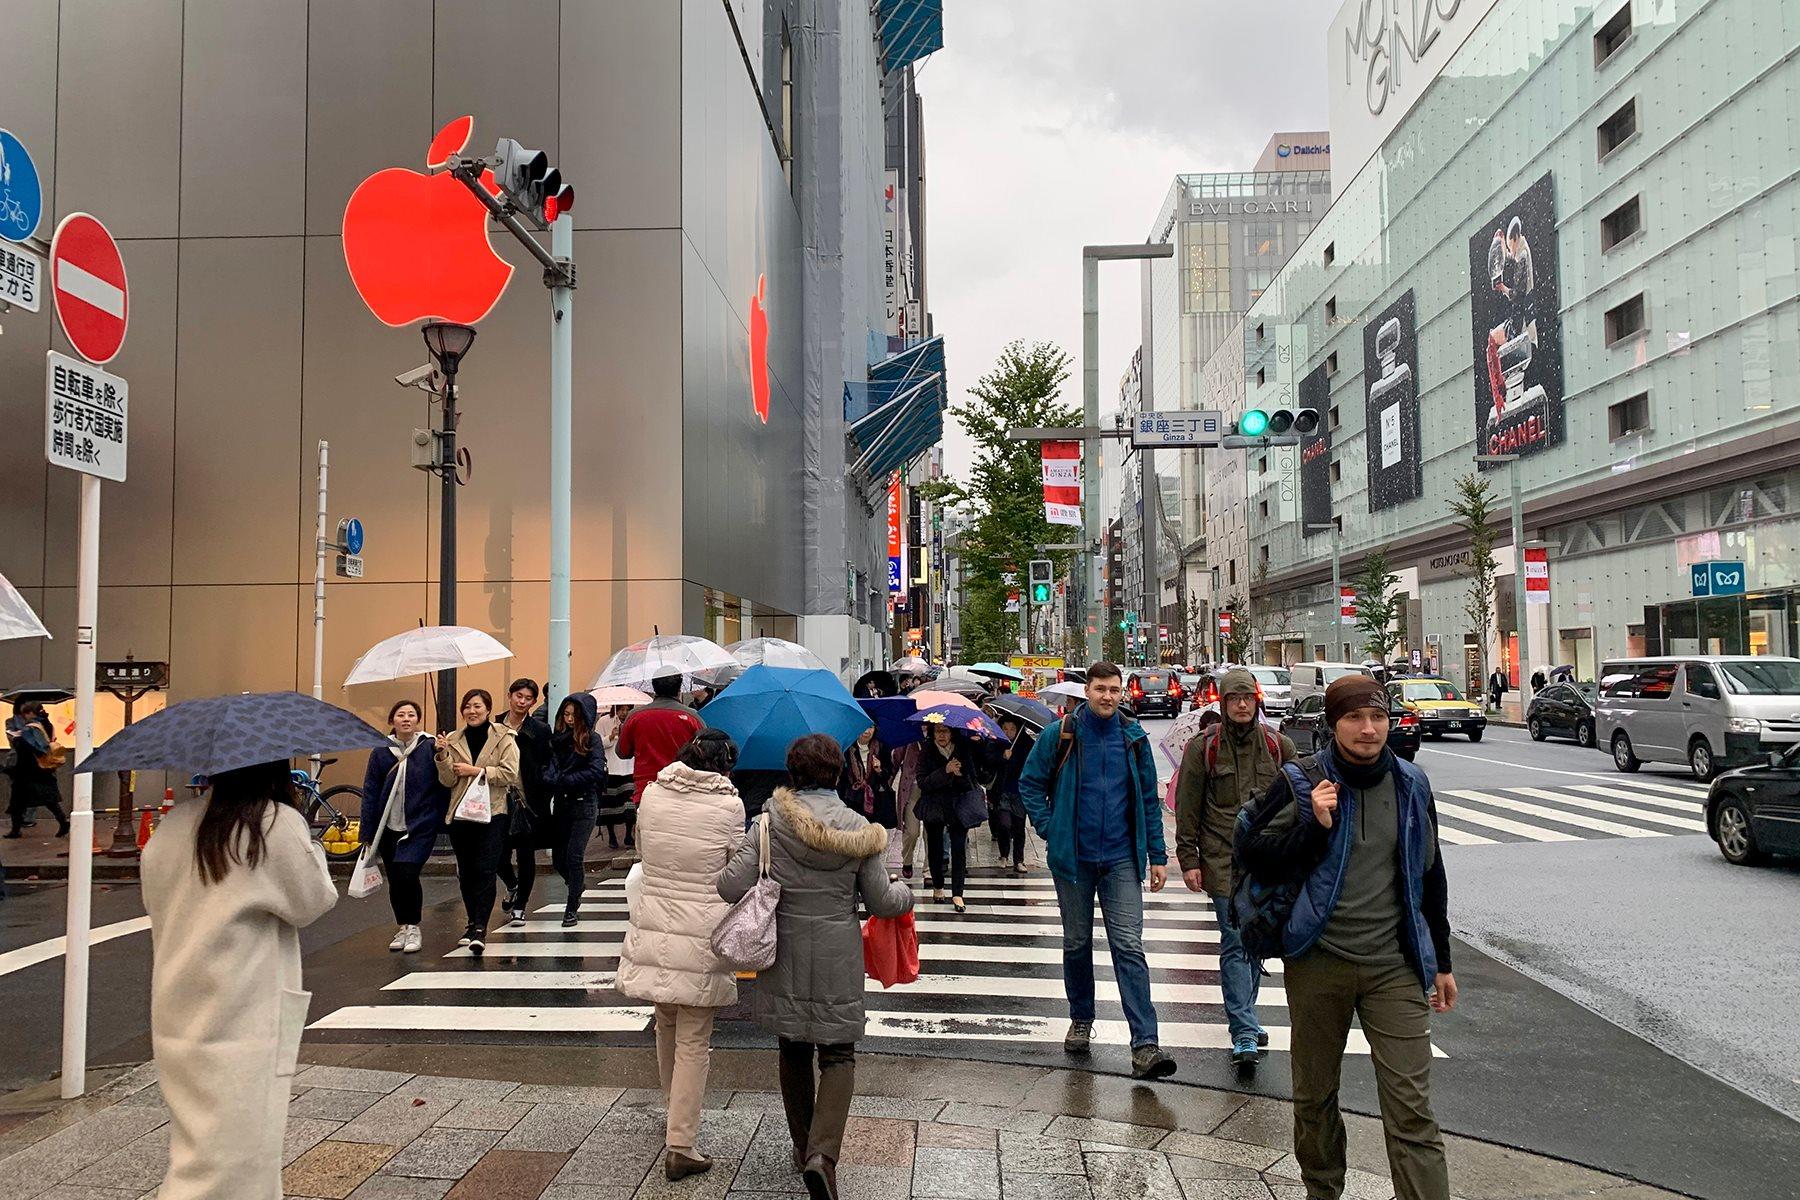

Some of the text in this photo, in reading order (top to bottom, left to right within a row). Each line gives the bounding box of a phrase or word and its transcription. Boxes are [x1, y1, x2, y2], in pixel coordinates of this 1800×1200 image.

[1190, 200, 1312, 215] BVLGARI
[54, 365, 124, 412] 自転車を除く
[53, 398, 123, 444] 歩行者天国実施
[1140, 419, 1217, 432] 銀座三丁目
[53, 429, 101, 466] 時間を除く
[1163, 433, 1185, 441] Ginza
[1487, 414, 1546, 456] CHANEL
[1023, 658, 1050, 667] 宝くじ
